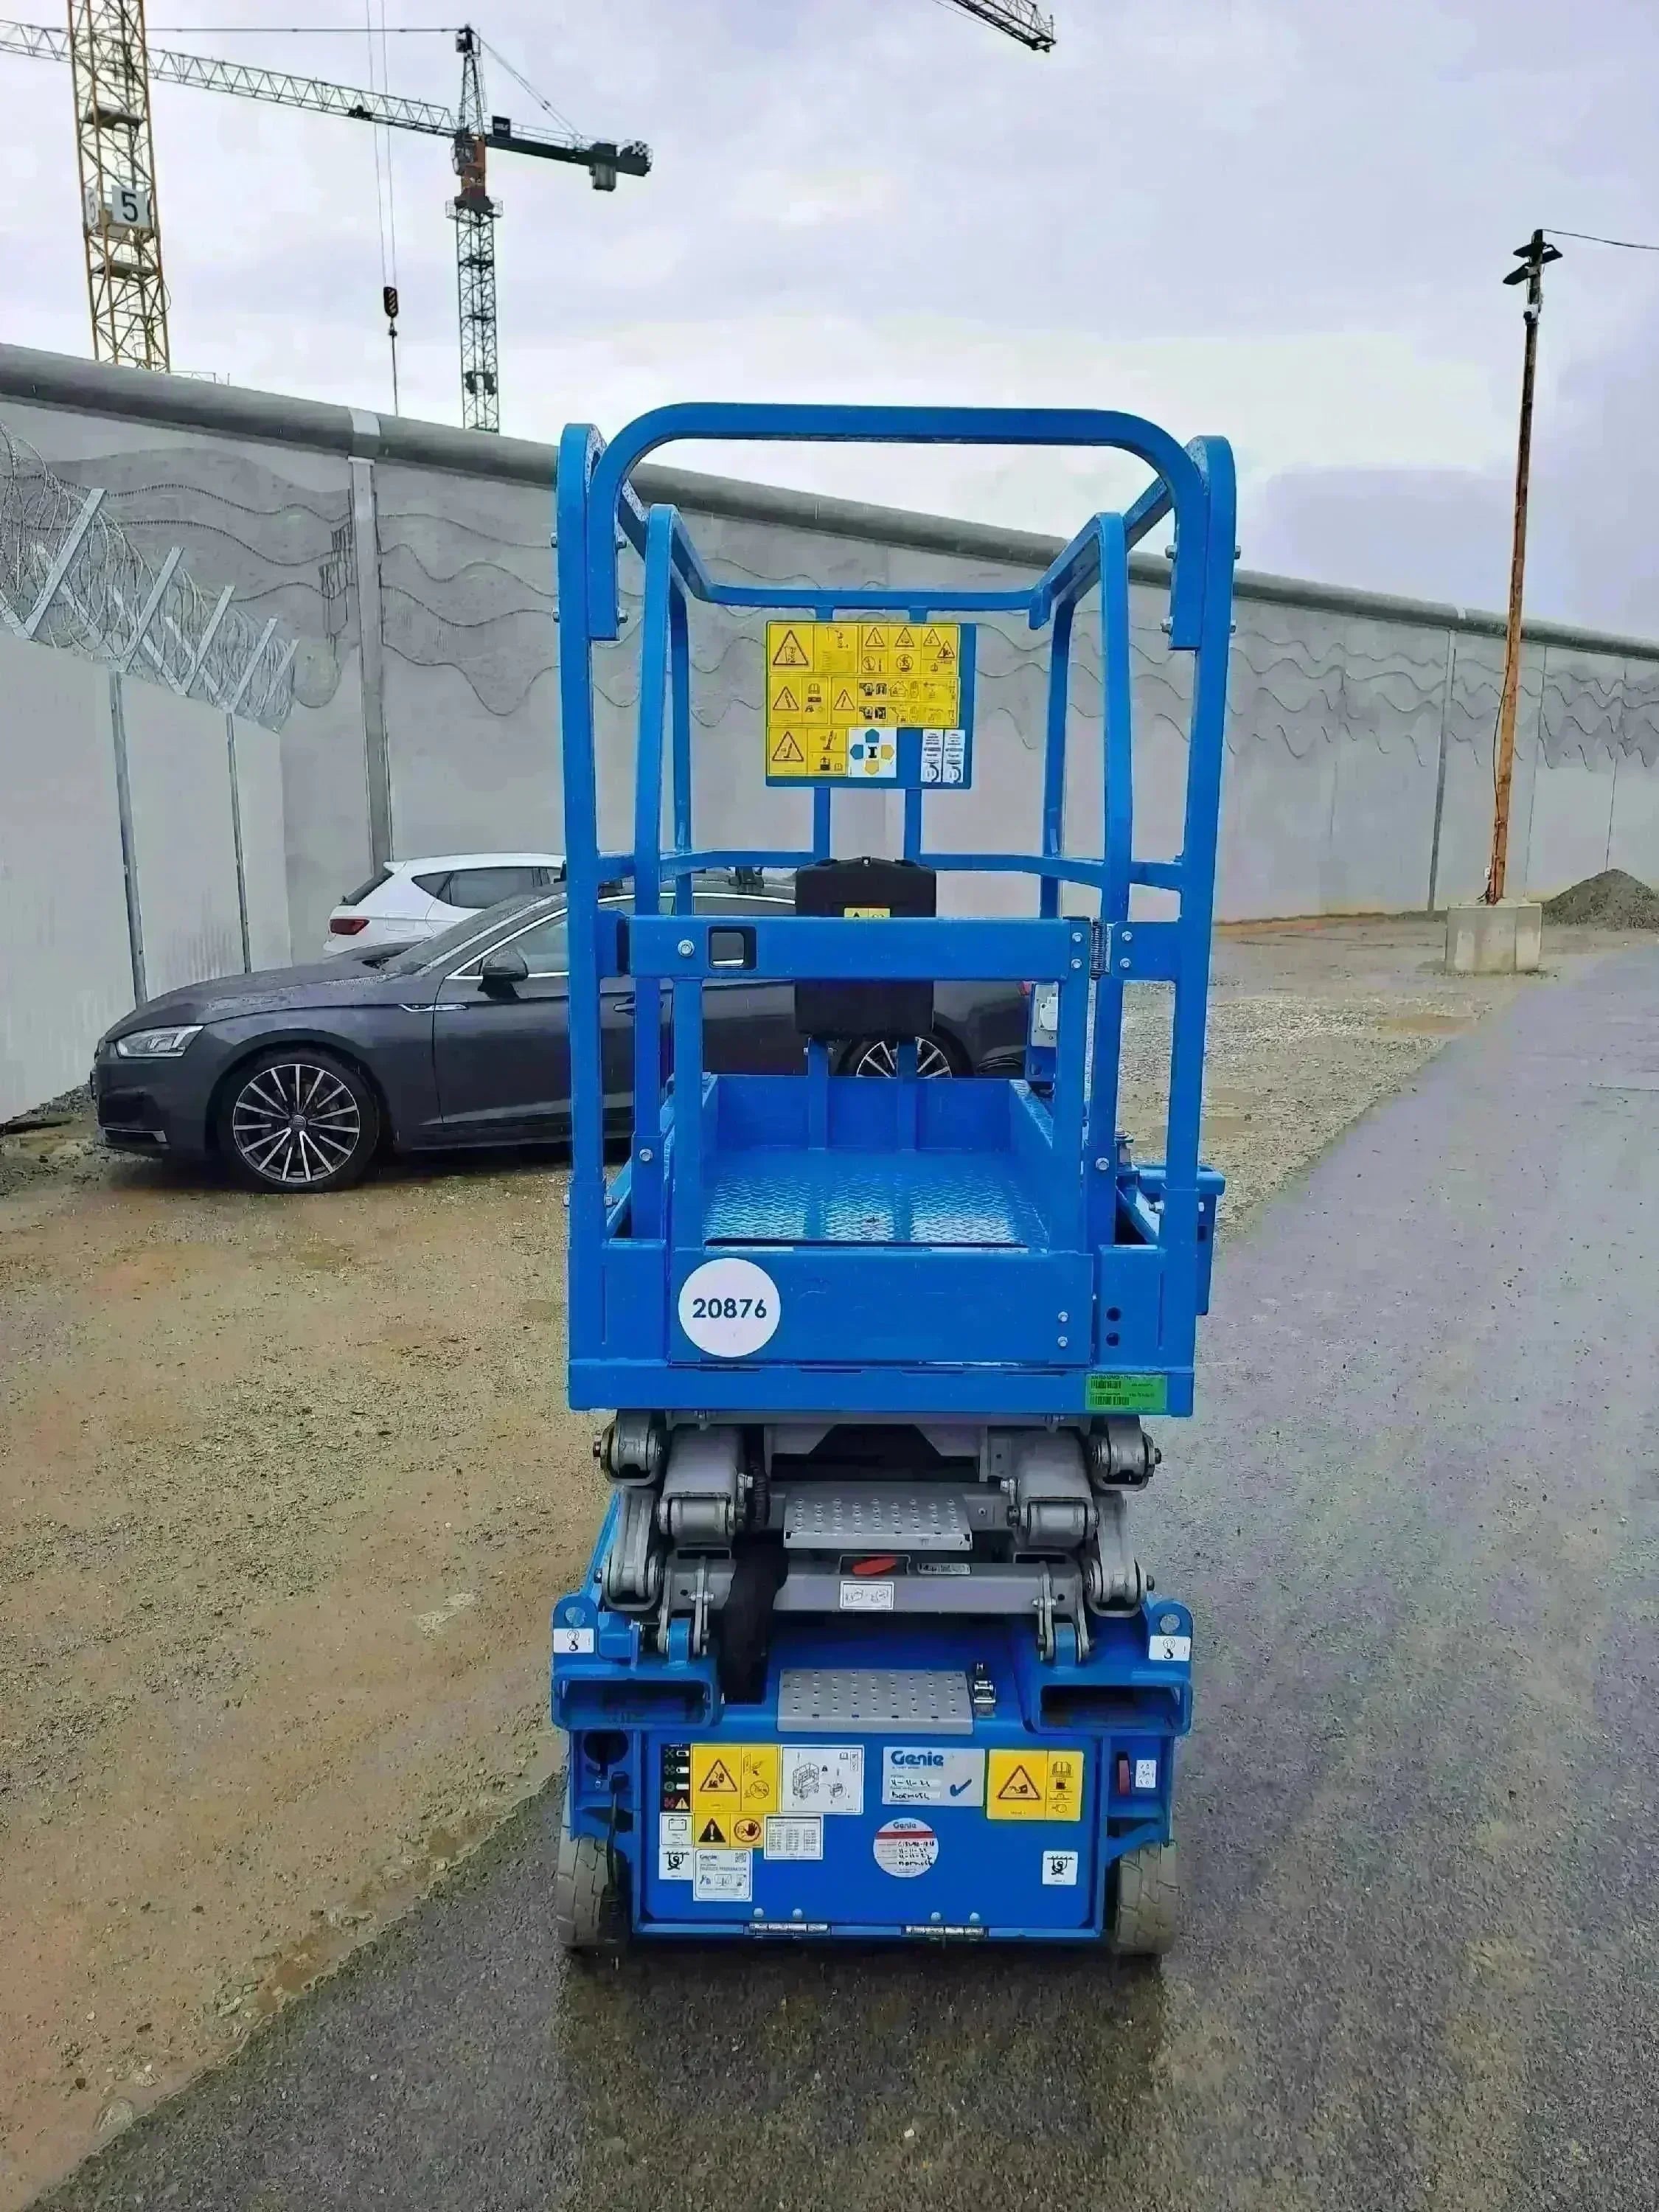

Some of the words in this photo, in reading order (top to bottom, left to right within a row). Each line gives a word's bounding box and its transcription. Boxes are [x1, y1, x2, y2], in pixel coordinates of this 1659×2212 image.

[121, 190, 139, 223] 5
[692, 1298, 767, 1318] 20876
[891, 1750, 944, 1767] Genie
[893, 1821, 917, 1829] Genie
